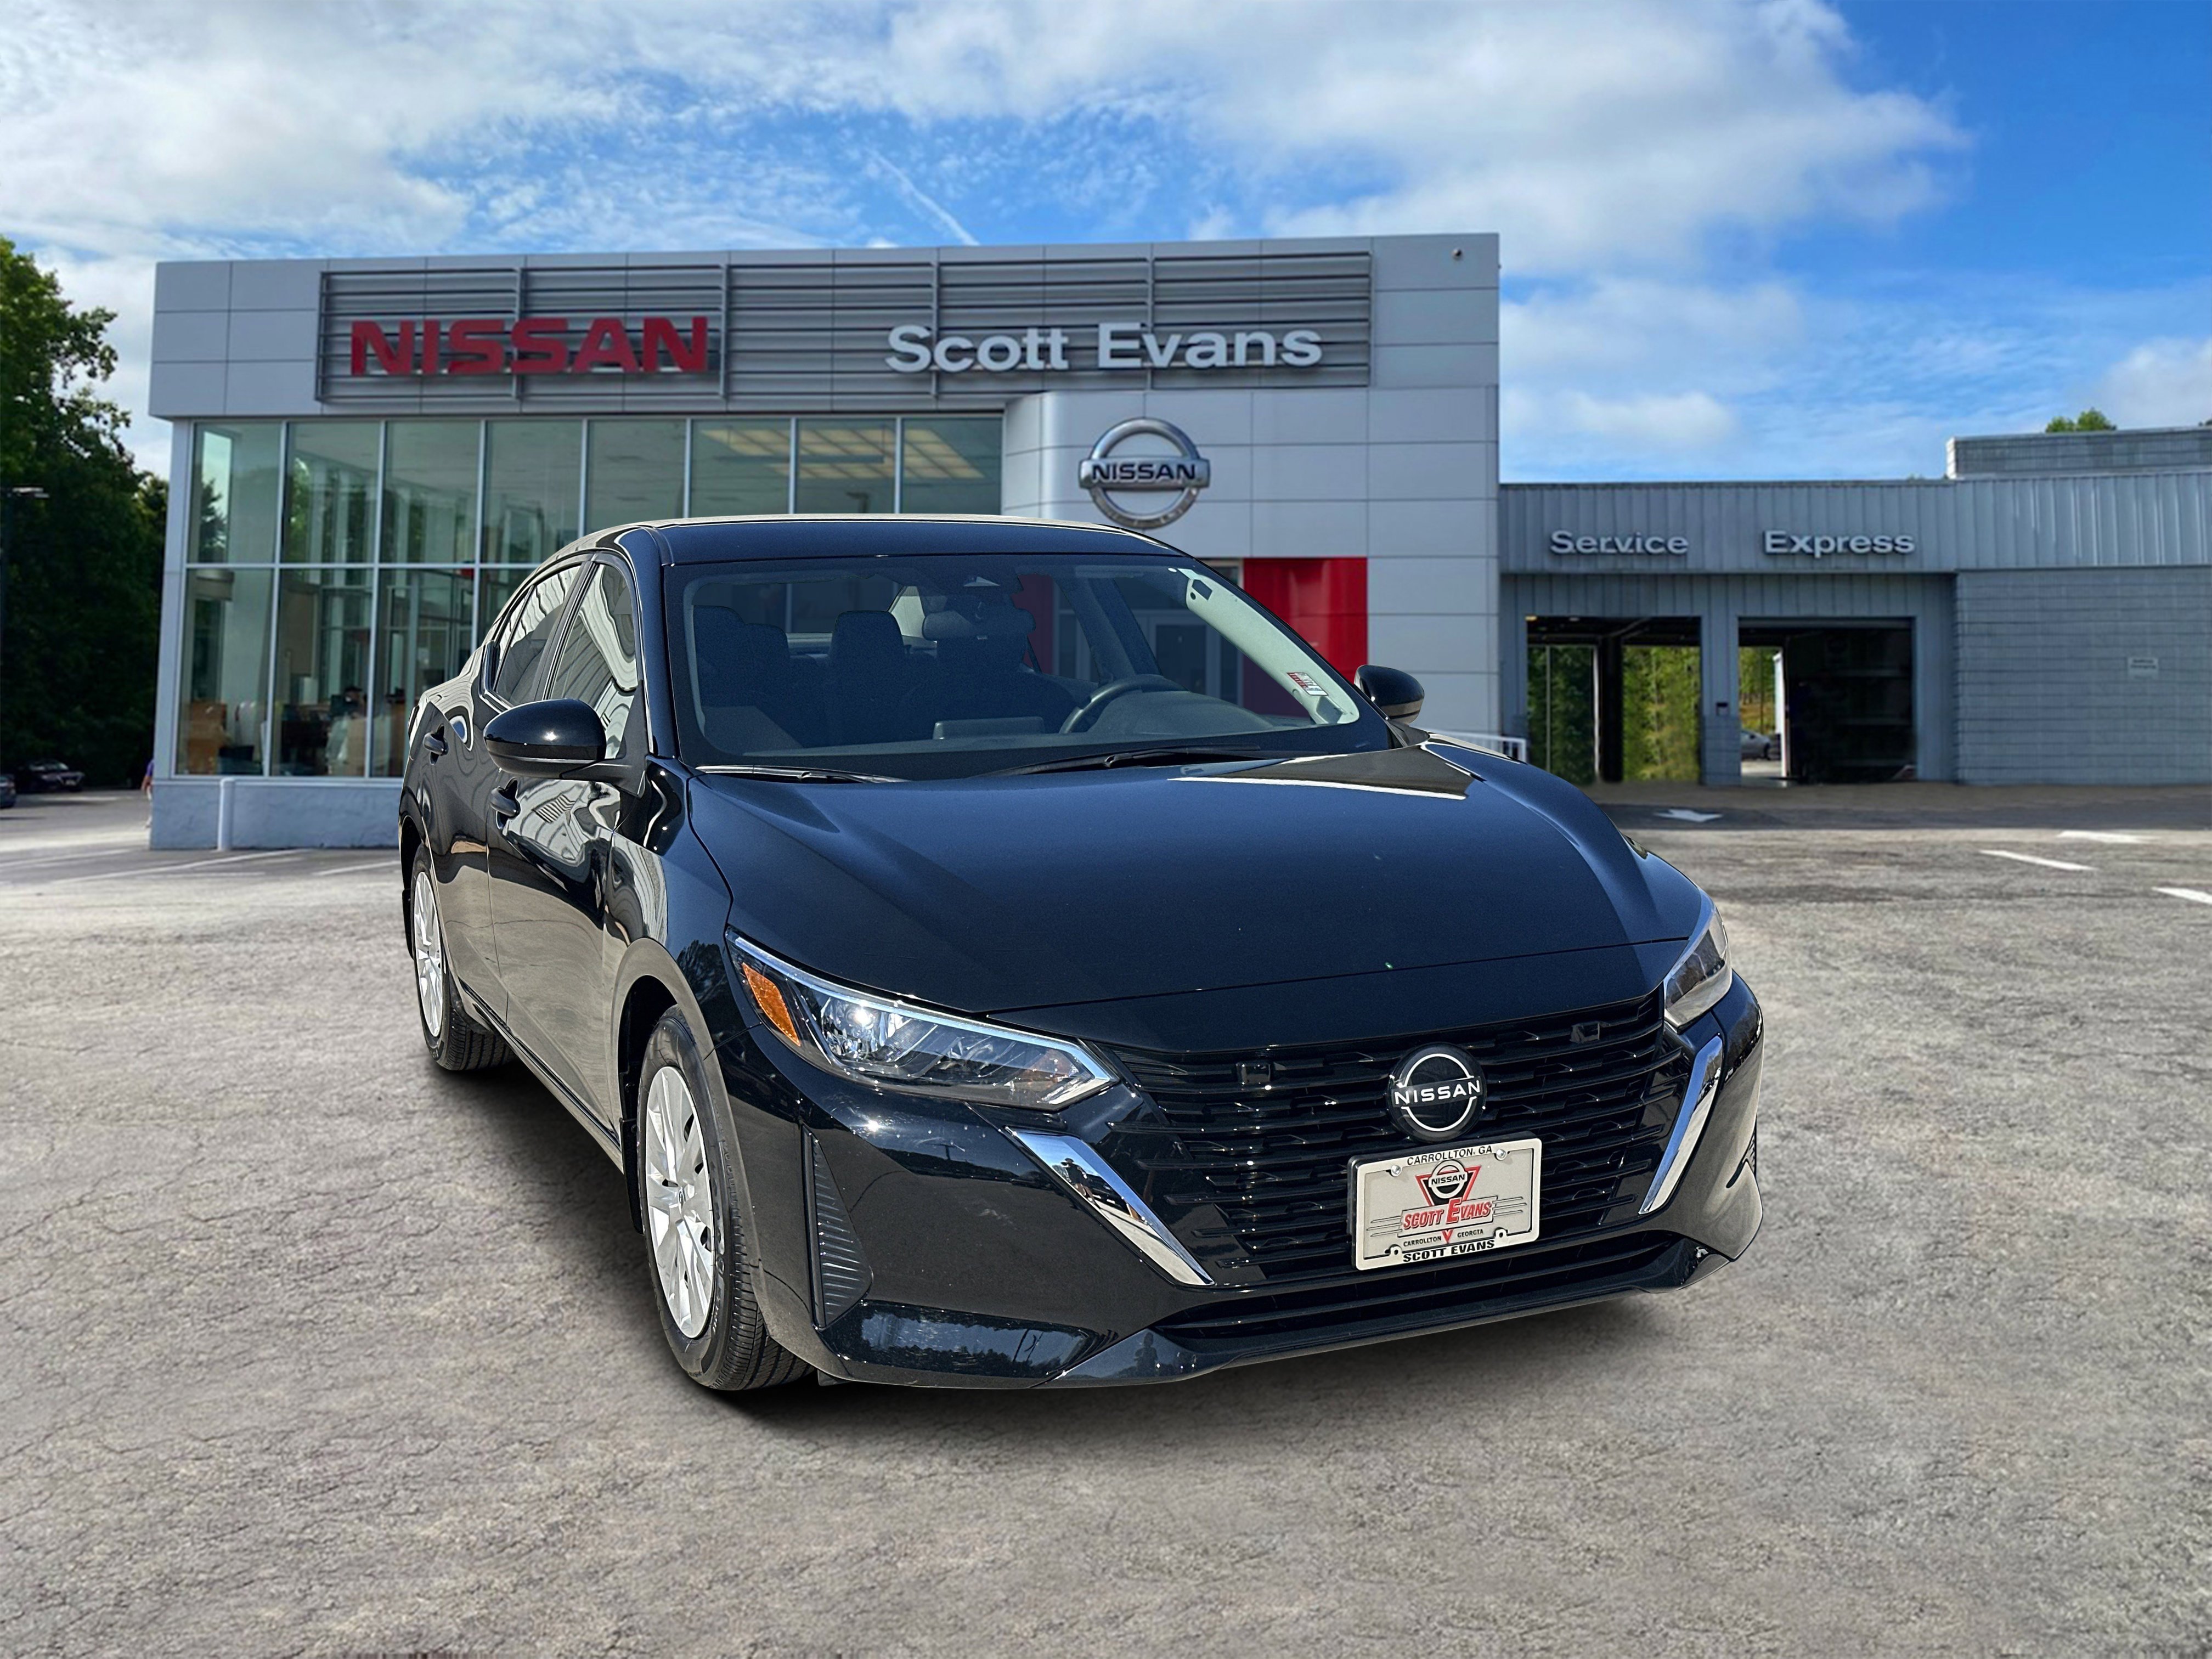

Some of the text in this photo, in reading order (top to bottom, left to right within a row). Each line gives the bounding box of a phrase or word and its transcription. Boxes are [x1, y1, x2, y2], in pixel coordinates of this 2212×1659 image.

[352, 317, 708, 375] NISSAN
[885, 322, 1323, 373] Scott Evans
[1092, 464, 1197, 482] NISSAN
[1550, 530, 1915, 558] Service Express
[1394, 1080, 1481, 1105] NISSAN
[1478, 1145, 1492, 1154] GA
[1431, 1174, 1465, 1185] NISSAN
[1403, 1198, 1492, 1229] SCOTT EVANS
[1403, 1229, 1483, 1247] CARROLLTON GEORGIA
[1402, 1240, 1495, 1262] SCOTT EVANS
